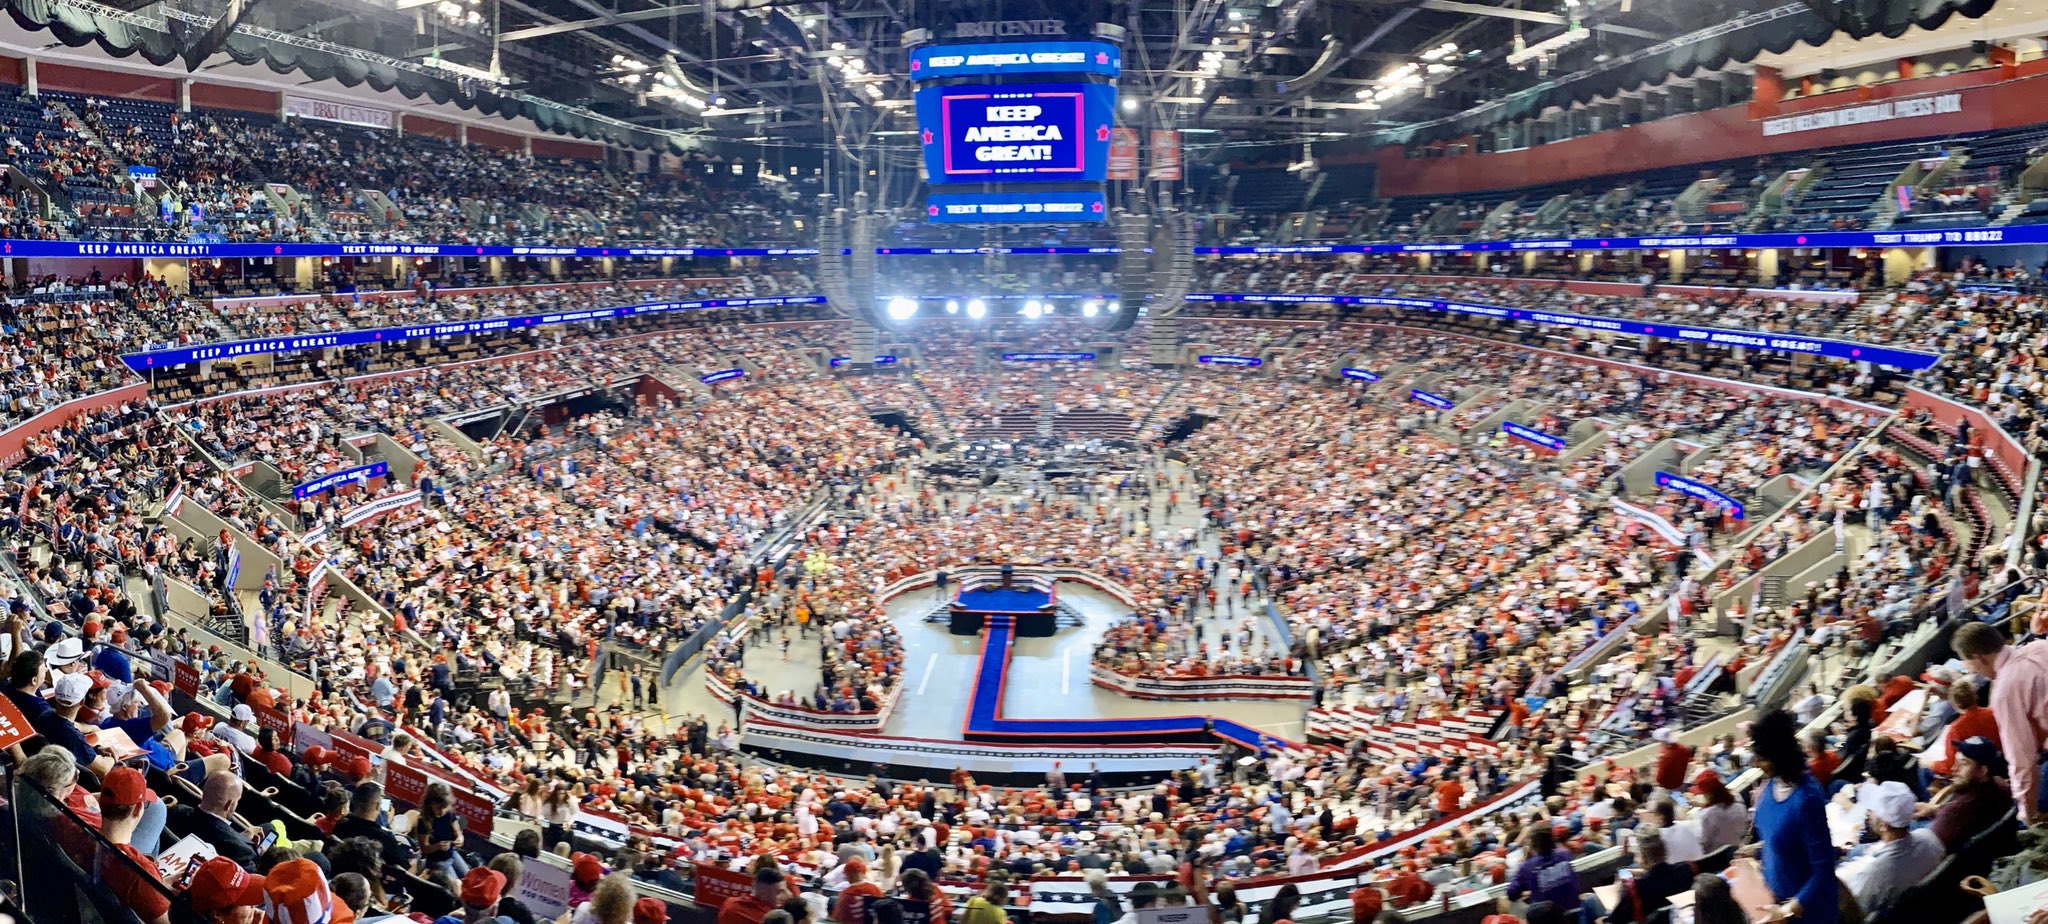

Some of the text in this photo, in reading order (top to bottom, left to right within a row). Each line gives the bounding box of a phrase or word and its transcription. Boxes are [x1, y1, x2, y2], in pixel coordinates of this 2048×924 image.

[313, 102, 390, 126] BB&T CENTER
[986, 105, 1042, 122] KEEP
[964, 125, 1063, 142] AMERICA
[975, 145, 1052, 162] GREAT!
[79, 244, 210, 255] KEEP AMERICA GREAT!
[342, 245, 366, 254] TEXT
[369, 245, 398, 254] TRUMP
[400, 246, 412, 254] TO
[405, 328, 431, 337] TEXT
[435, 325, 466, 335] TRUMP
[468, 323, 482, 331] TO
[192, 336, 337, 360] KEEP AMERICA GREAT!
[178, 668, 198, 682] TRUMP
[261, 711, 287, 728] TRUMP
[390, 770, 425, 788] TRUMP
[521, 869, 565, 898] Women
[521, 889, 562, 907] FOR TRUMP
